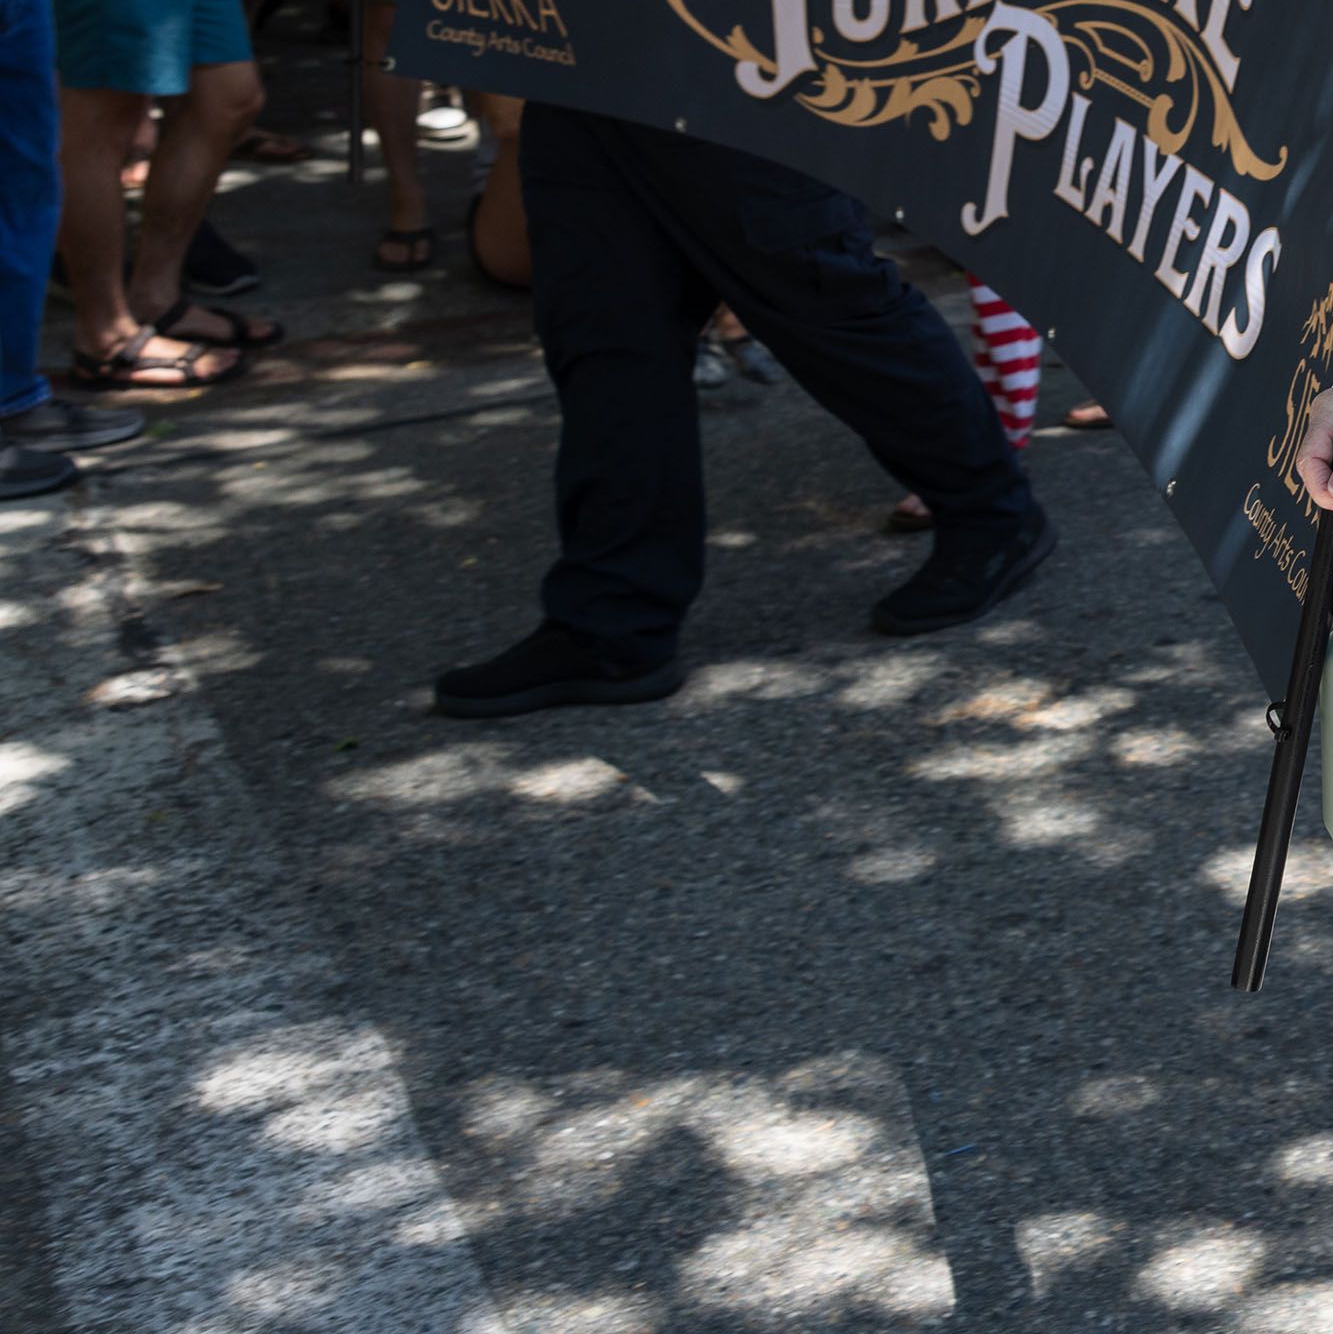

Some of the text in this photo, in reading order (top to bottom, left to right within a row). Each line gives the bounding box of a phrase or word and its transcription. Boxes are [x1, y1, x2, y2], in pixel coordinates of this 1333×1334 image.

[426, 19, 577, 66] County Arts Council
[960, 0, 1282, 361] PLAYERS
[1243, 482, 1278, 560] County
[1267, 522, 1295, 572] Arts
